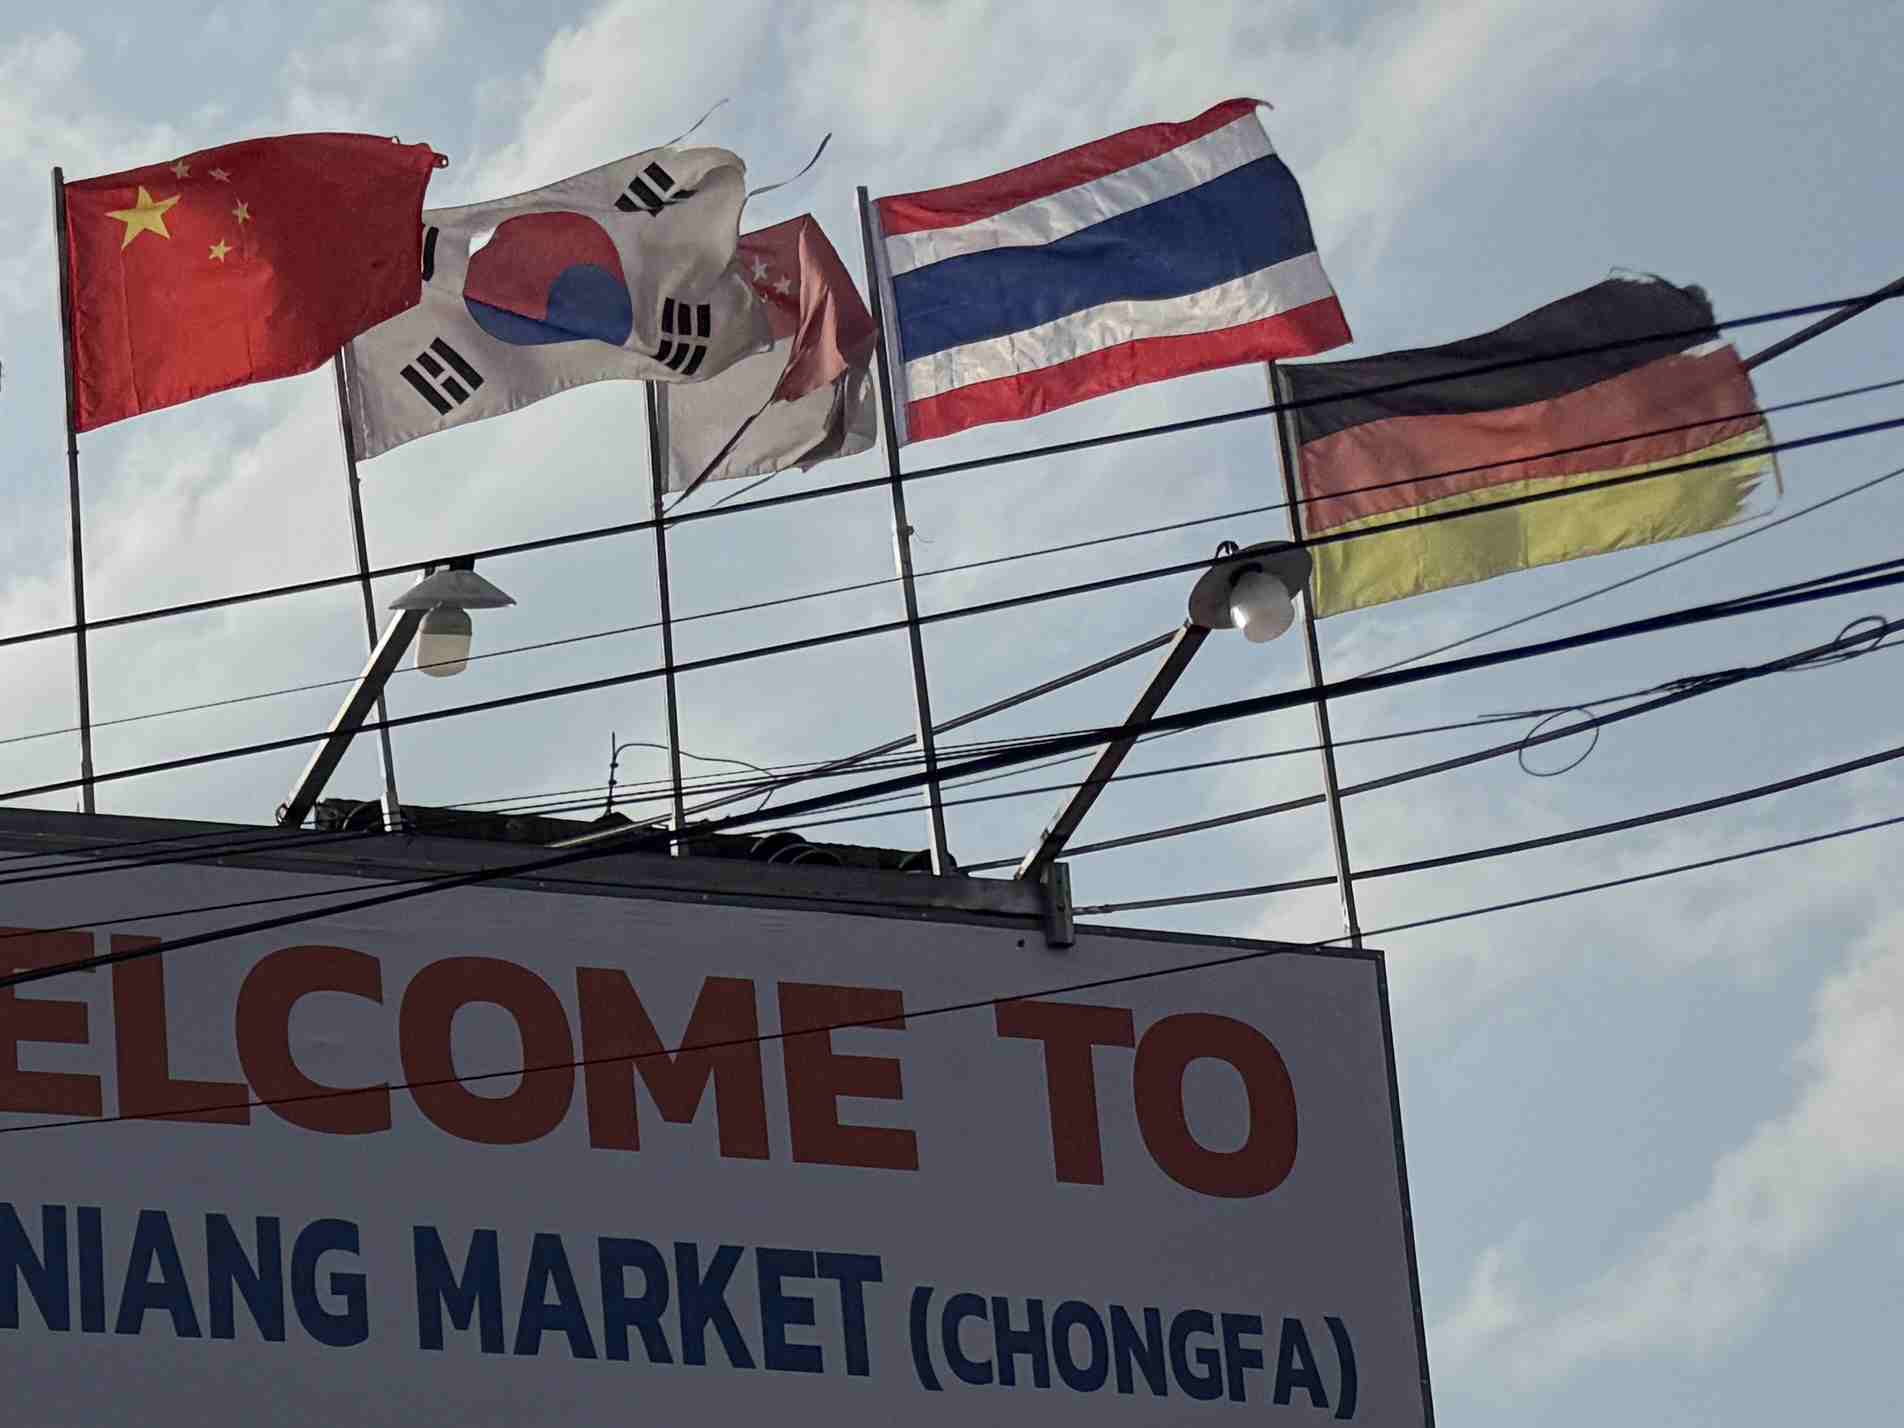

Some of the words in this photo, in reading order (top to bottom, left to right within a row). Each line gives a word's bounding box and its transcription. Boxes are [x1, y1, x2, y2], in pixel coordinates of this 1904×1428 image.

[994, 1001, 1299, 1198] TO
[413, 1225, 882, 1378] MARKET
[908, 1286, 1358, 1420] (CHONGFA)
